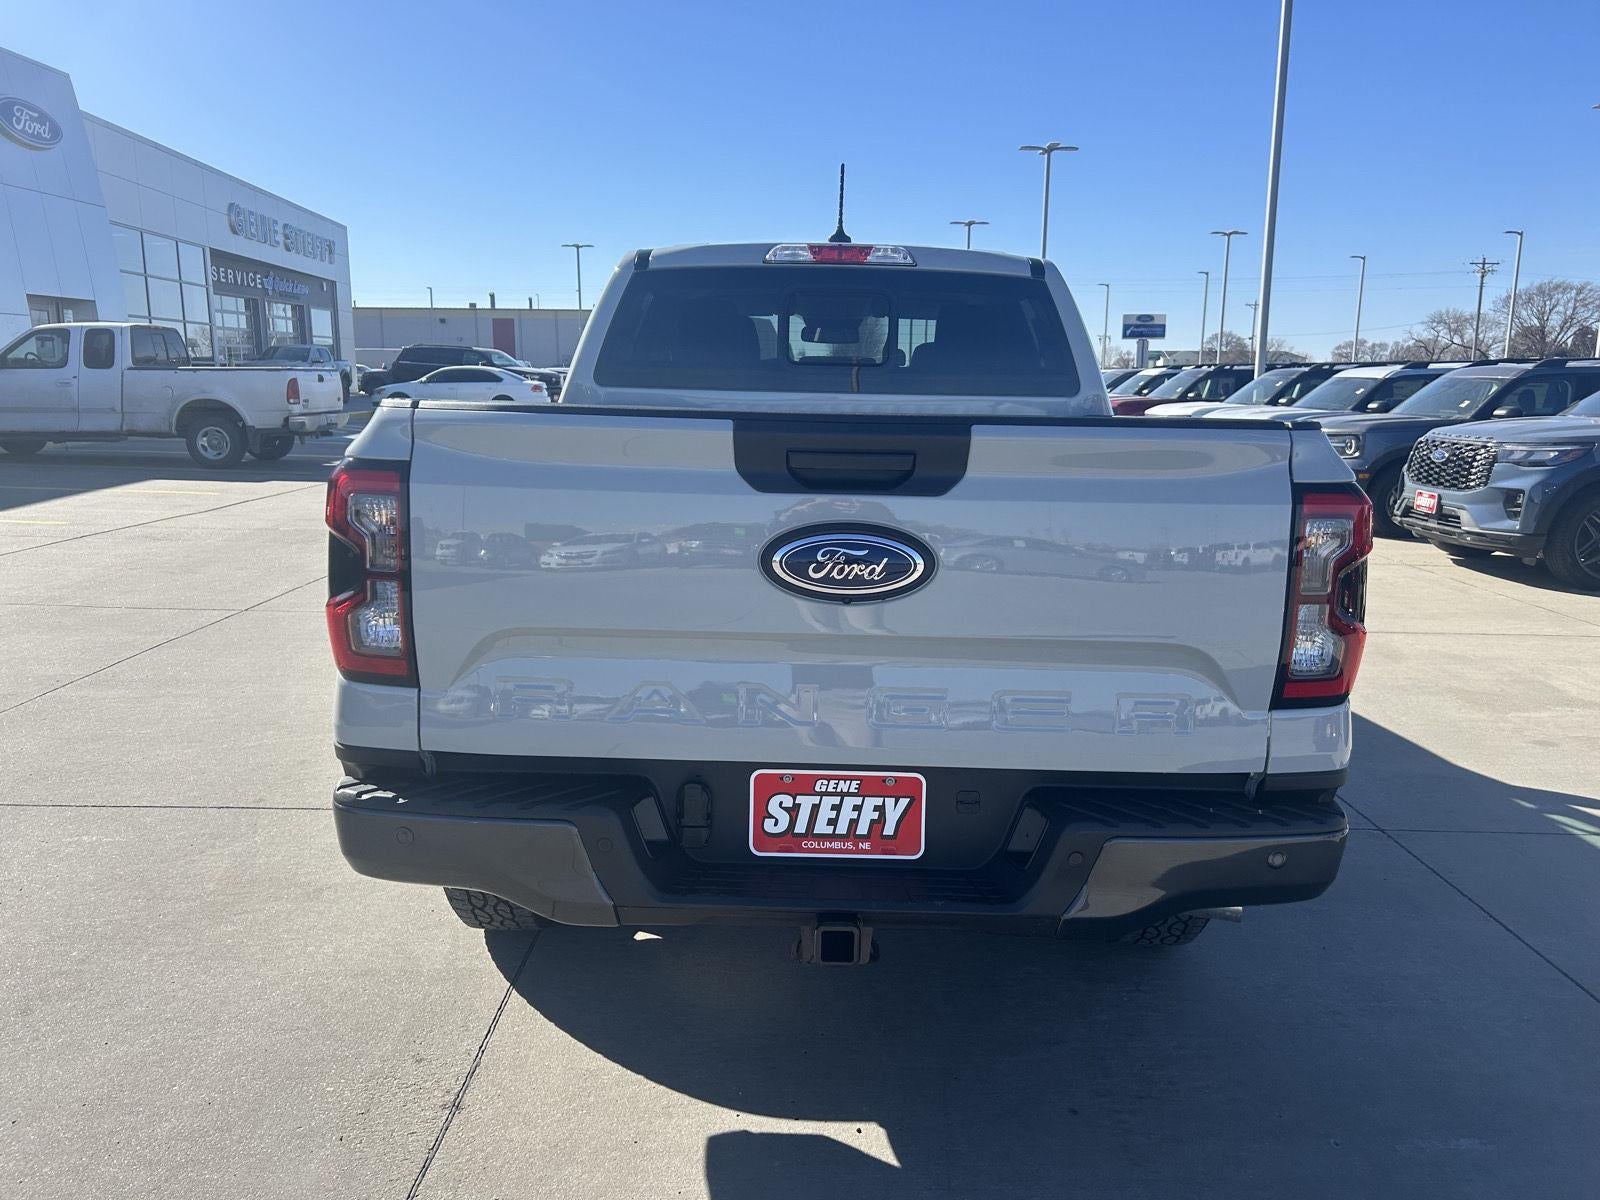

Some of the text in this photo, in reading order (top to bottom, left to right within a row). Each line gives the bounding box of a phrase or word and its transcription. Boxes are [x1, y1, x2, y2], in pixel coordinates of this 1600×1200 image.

[12, 105, 51, 139] Ford
[227, 202, 280, 247] GENE
[211, 265, 262, 289] SERVICE
[808, 547, 889, 580] Ford
[494, 676, 1196, 736] RANGER
[814, 779, 862, 793] GENE
[762, 793, 912, 838] STEFFY
[801, 840, 872, 851] COLUMBUS, NE
